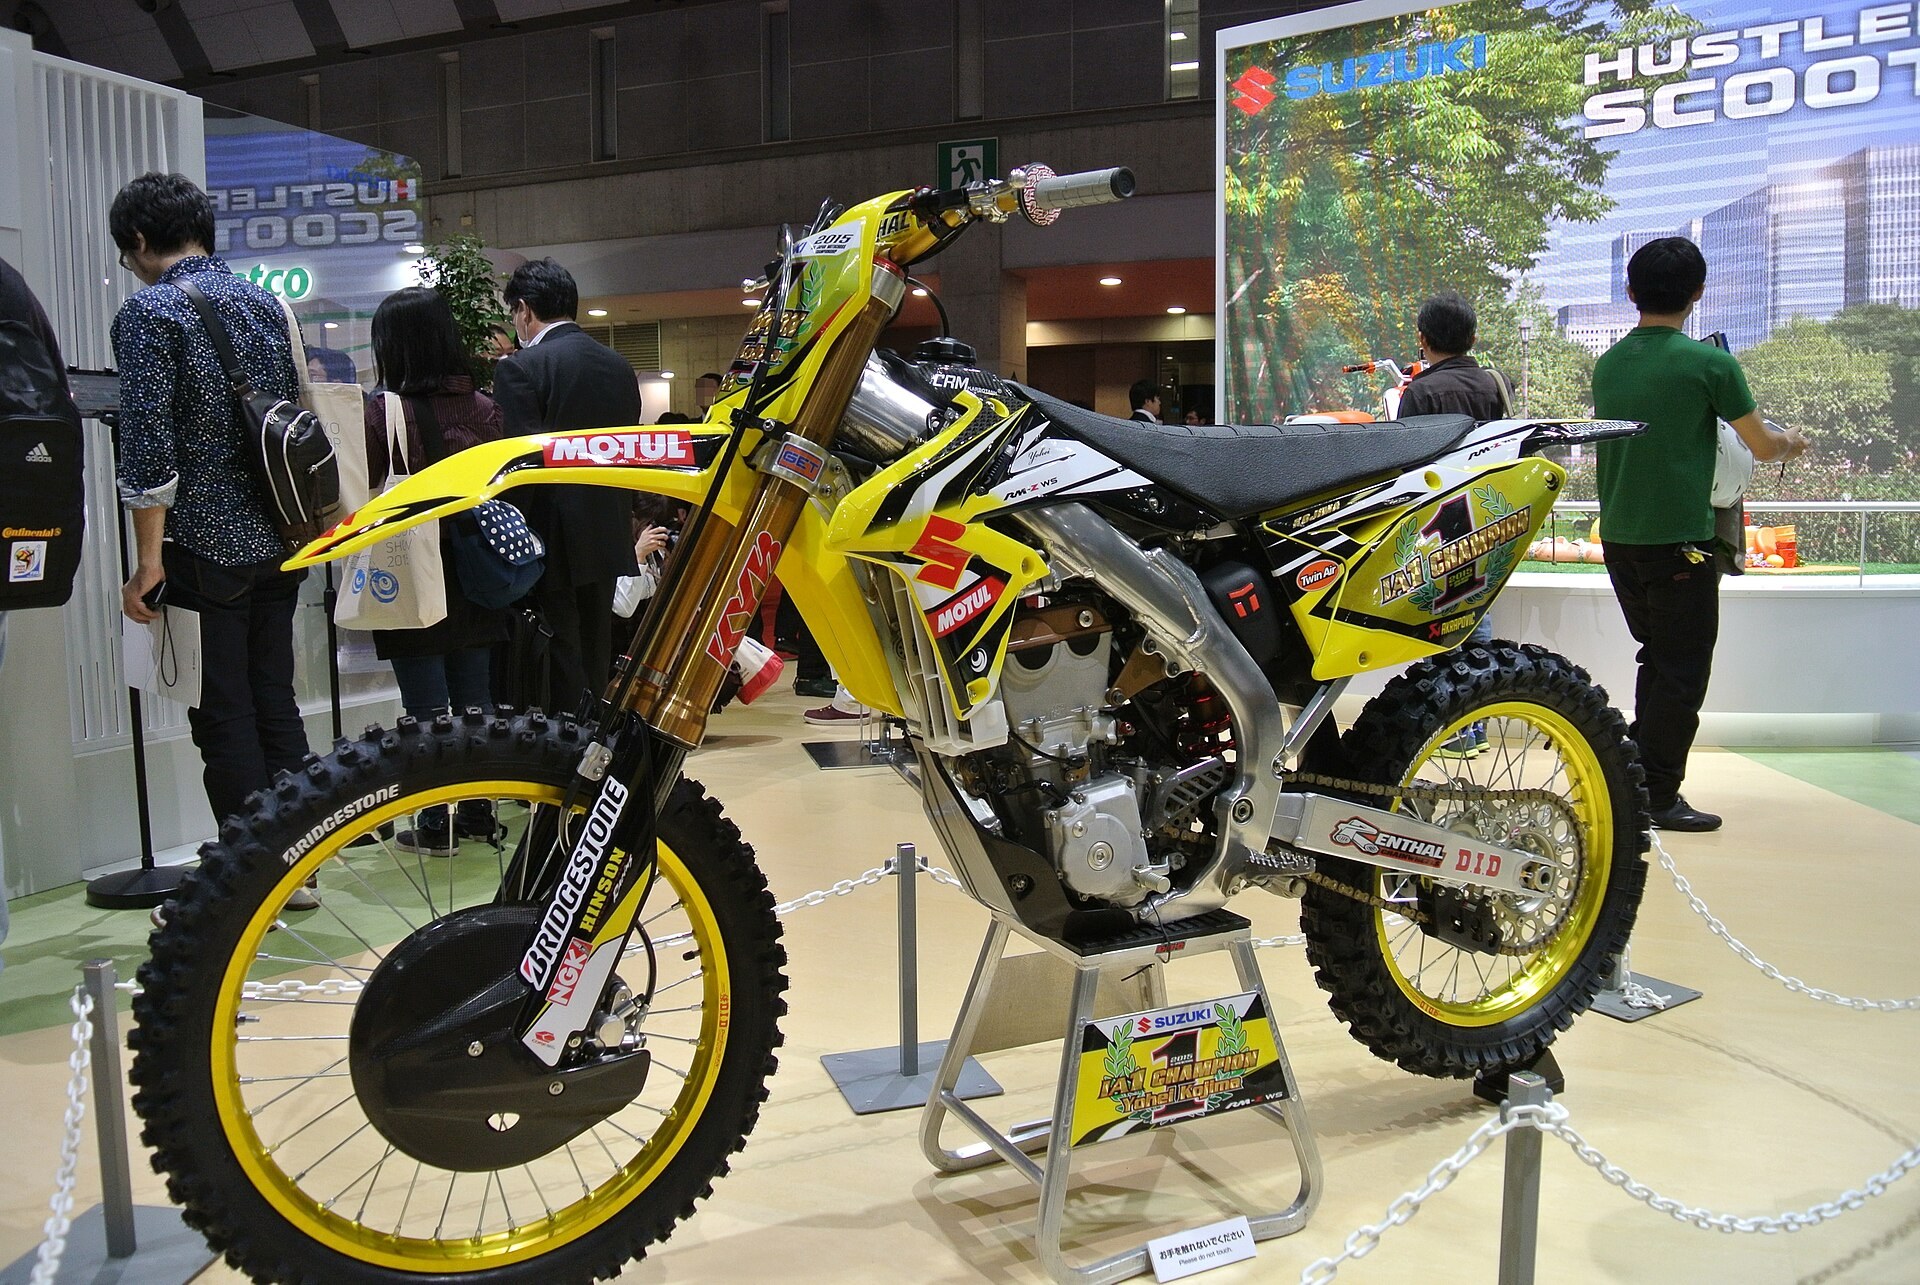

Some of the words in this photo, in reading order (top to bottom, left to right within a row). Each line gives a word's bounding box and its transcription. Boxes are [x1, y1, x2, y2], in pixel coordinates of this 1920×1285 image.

[1584, 1, 1920, 86] HUSTLE
[1285, 35, 1487, 100] SUZUKI
[814, 234, 854, 245] 2015
[932, 373, 970, 391] CRM
[25, 455, 52, 463] adidas
[551, 433, 687, 461] MOTUL
[1468, 442, 1501, 460] RM-Z
[782, 450, 820, 474] GET
[1004, 483, 1039, 501] RM-Z
[1041, 477, 1058, 488] WS
[1431, 507, 1531, 578] CHAMPION
[1301, 571, 1322, 586] Twin
[1323, 565, 1336, 578] Air
[937, 584, 992, 633] MOTUL
[282, 784, 399, 866] BRIDGESTONE
[521, 777, 628, 990] BRIDGESTONE
[579, 847, 626, 933] HINSON
[549, 946, 588, 1004] NGK
[1154, 1008, 1211, 1028] SUZUKI
[1151, 1051, 1259, 1087] CHAMPION
[1180, 1078, 1242, 1100] Kojima
[1225, 1096, 1262, 1109] RM-Z
[1265, 1092, 1283, 1100] WS
[1160, 1230, 1245, 1260] お手を触れないでください
[1179, 1256, 1198, 1266] Please
[1199, 1252, 1206, 1261] do
[1206, 1251, 1216, 1259] not
